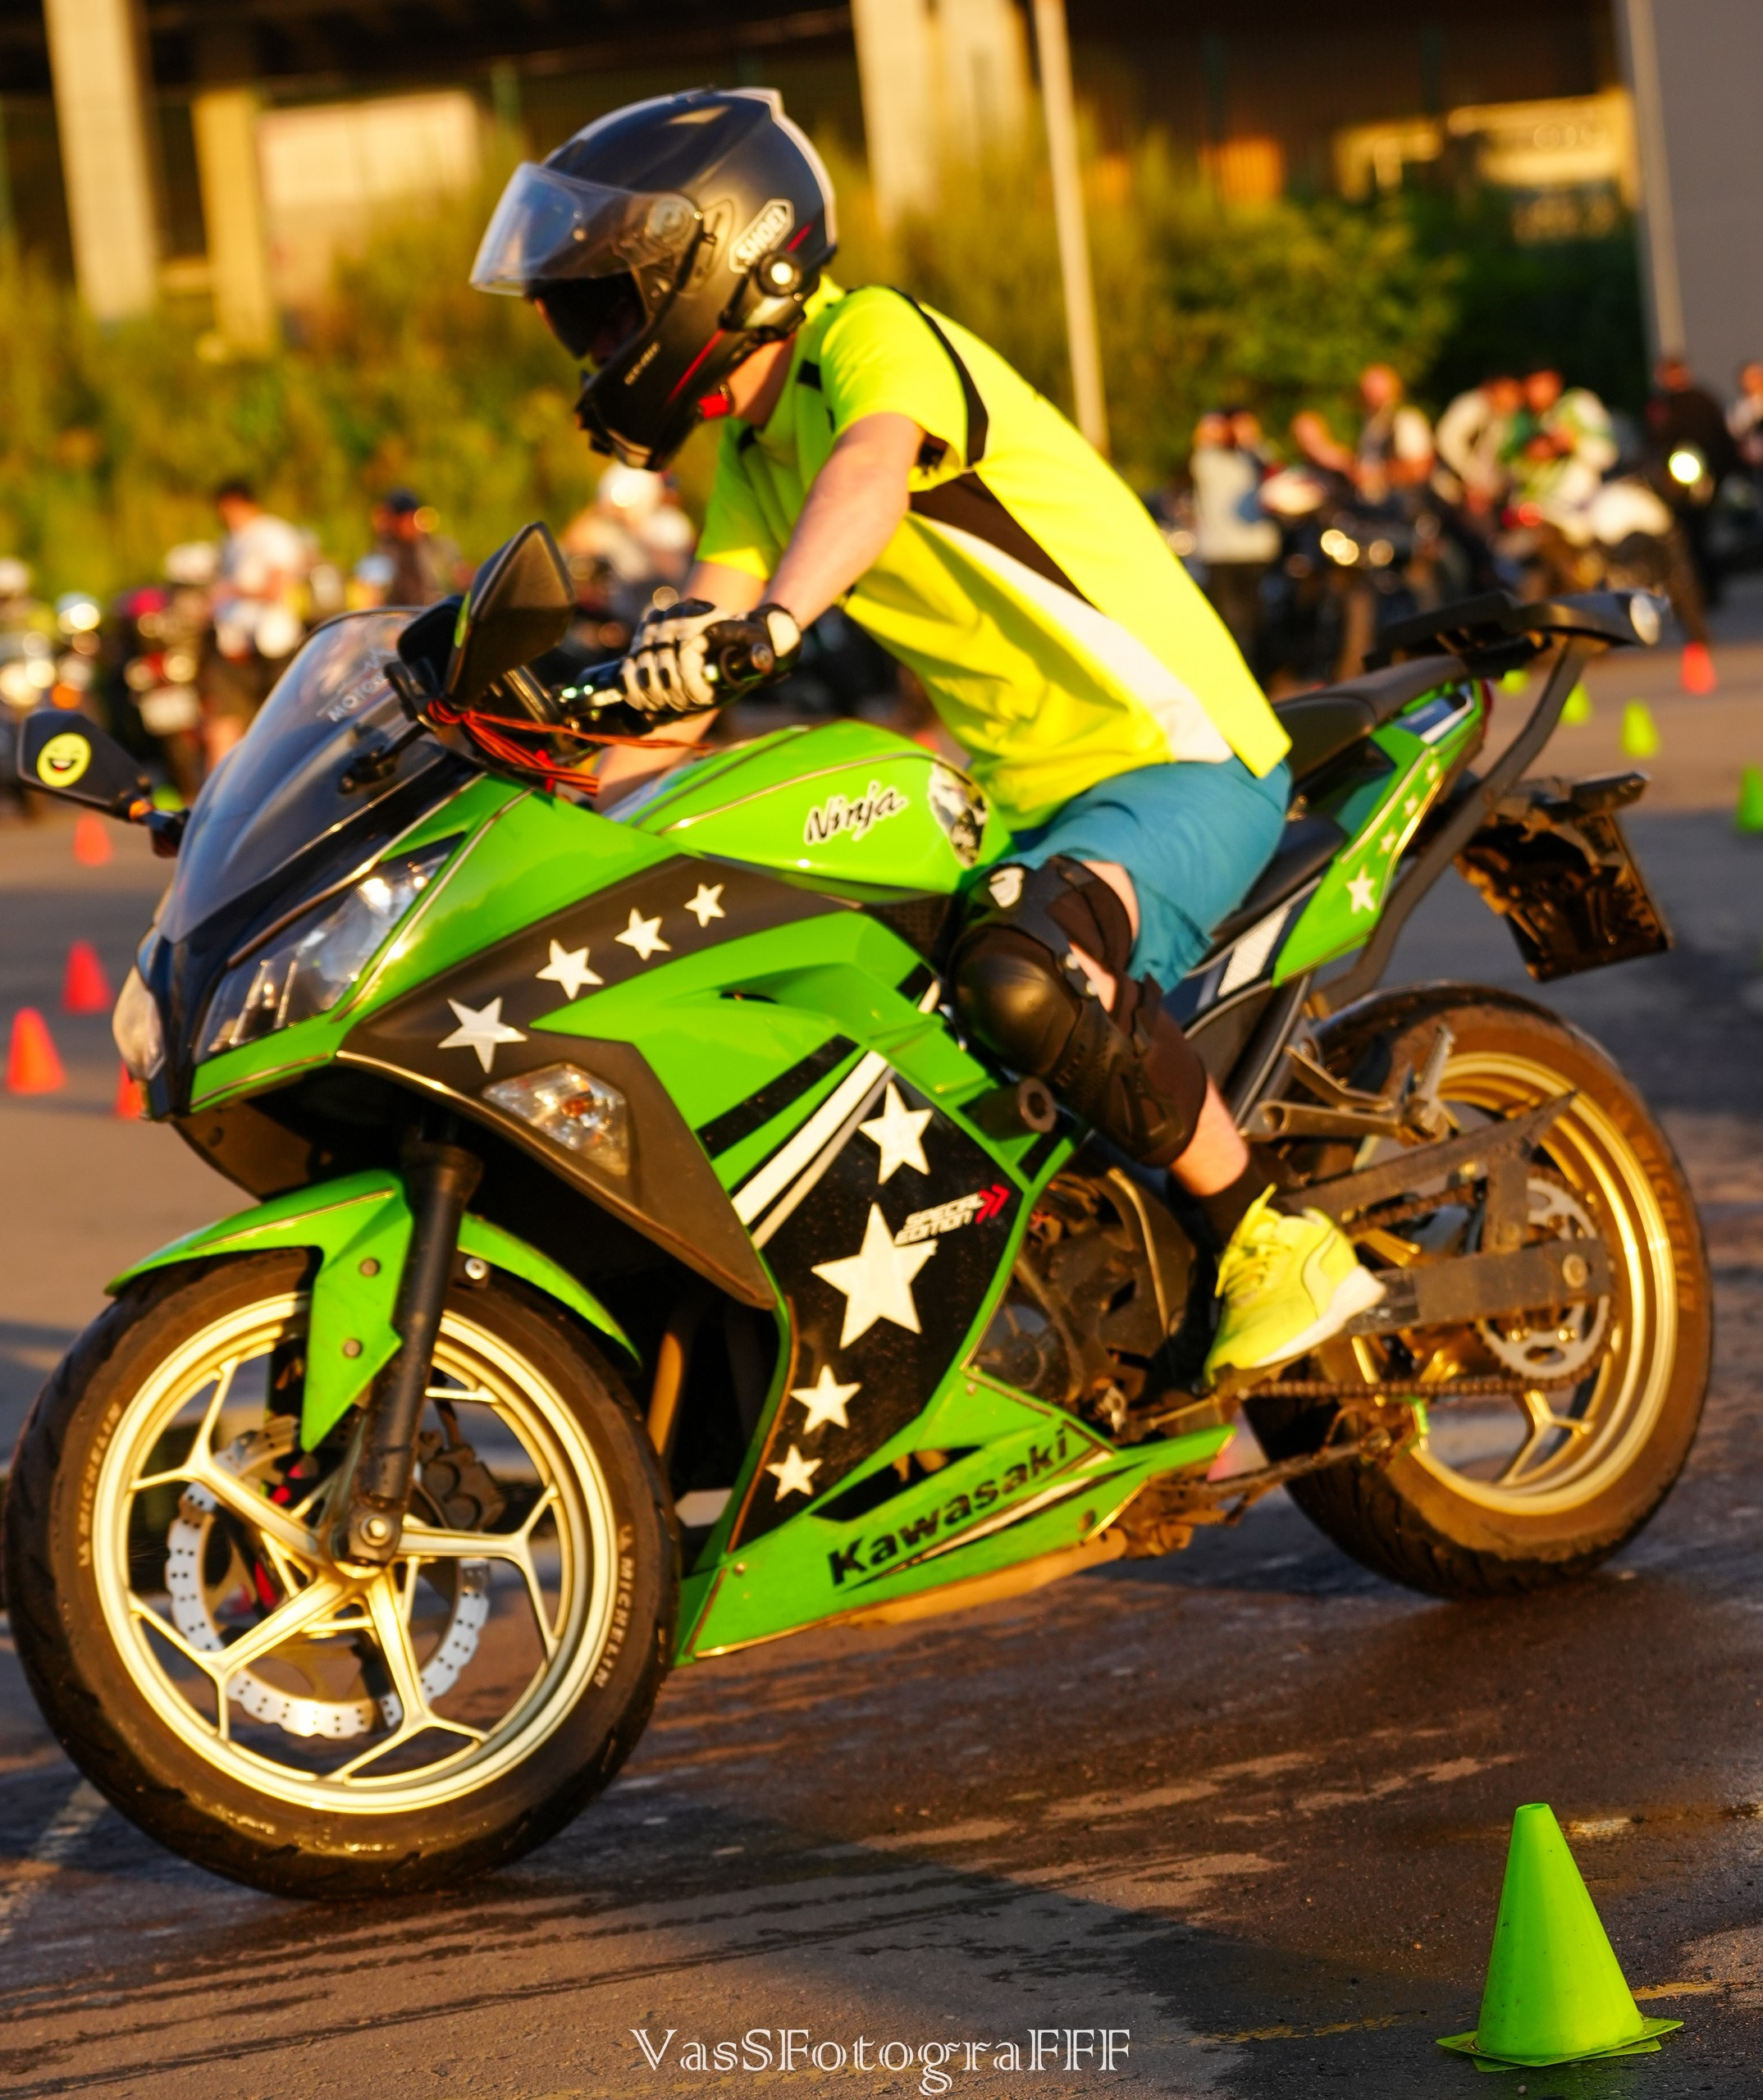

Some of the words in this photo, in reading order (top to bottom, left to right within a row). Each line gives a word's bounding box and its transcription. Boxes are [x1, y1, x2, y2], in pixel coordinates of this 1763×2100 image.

[734, 205, 788, 266] SHOEI
[804, 779, 908, 846] Ninja
[903, 1192, 984, 1229] SPECIAL
[828, 1428, 1067, 1586] Kawasaki
[594, 1556, 635, 1688] MICHELIN
